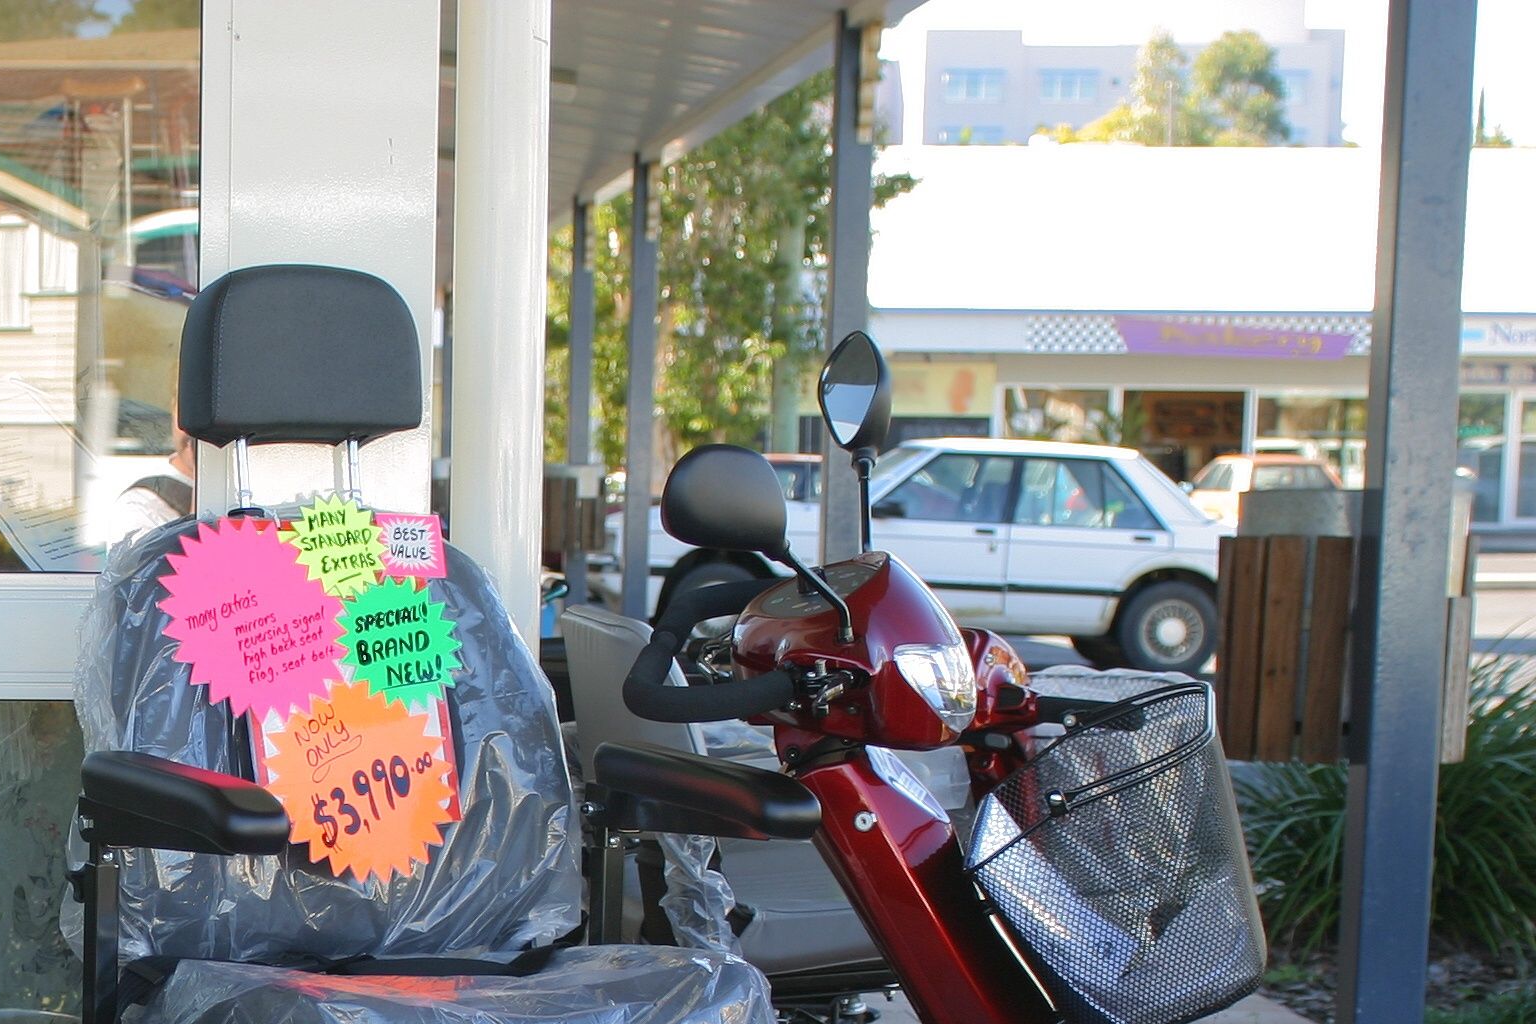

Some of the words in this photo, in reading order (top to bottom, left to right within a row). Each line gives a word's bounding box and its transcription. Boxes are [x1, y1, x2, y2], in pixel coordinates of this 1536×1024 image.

[308, 509, 346, 531] MANY
[393, 527, 426, 541] BEST
[301, 528, 371, 551] STANDARD
[390, 544, 431, 560] VALUE
[321, 547, 376, 573] EXTRA'S
[185, 607, 218, 632] many
[234, 612, 277, 636] mirrors
[238, 623, 291, 651] reversing
[291, 605, 325, 633] signal
[243, 647, 267, 670] high
[271, 637, 297, 656] back
[299, 625, 324, 647] seat
[282, 656, 306, 673] seat
[312, 645, 335, 662] belt
[356, 630, 430, 666] BRAND
[386, 654, 442, 686] NEW!
[294, 704, 335, 746] NOW
[306, 719, 350, 767] ONLY
[311, 751, 432, 853] $3,990.00
